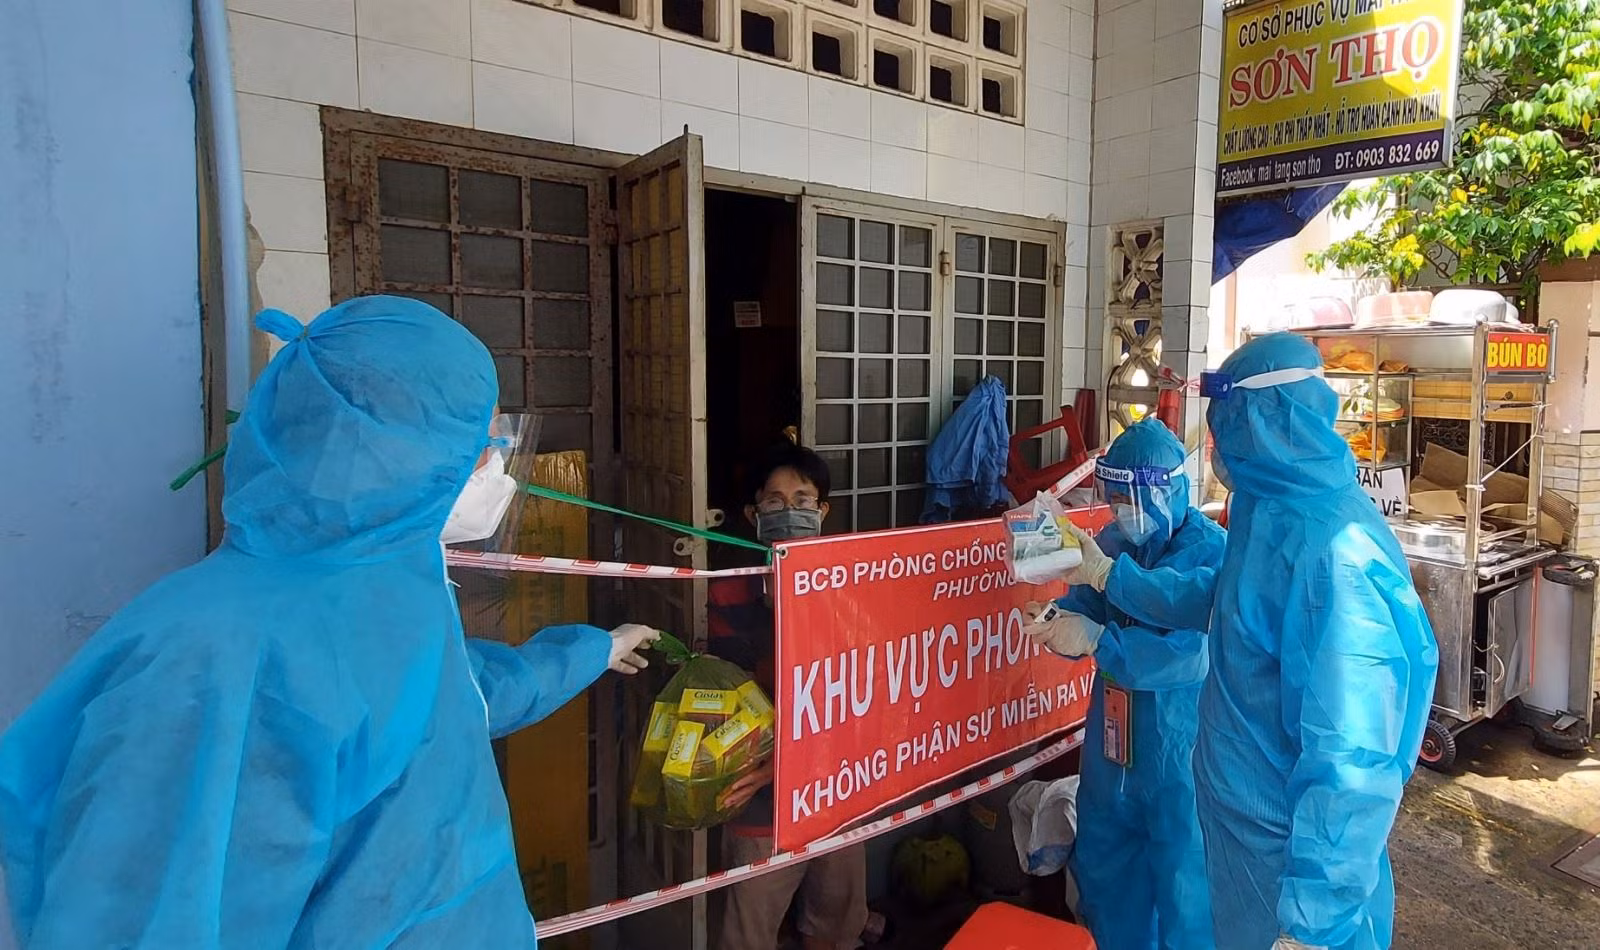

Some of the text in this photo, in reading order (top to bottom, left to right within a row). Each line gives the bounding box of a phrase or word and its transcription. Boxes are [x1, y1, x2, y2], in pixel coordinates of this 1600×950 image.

[1239, 18, 1258, 48] CƠ
[1261, 5, 1282, 41] SỞ
[1284, 2, 1325, 34] PHỤC
[1330, 0, 1350, 24] VỤ
[1229, 20, 1439, 108] SƠN THỌ
[1224, 122, 1238, 155] CHẤT
[1239, 124, 1257, 157] LƯỢNG
[1257, 124, 1269, 149] CAO
[1273, 121, 1283, 147] CHI
[1284, 113, 1297, 145] PHÍ
[1297, 107, 1313, 142] THẤP
[1313, 102, 1331, 139] NHẤT
[1347, 104, 1361, 136] TRỢ
[1361, 97, 1380, 131] HOÀN
[1381, 91, 1401, 129] CẢNH
[1221, 139, 1440, 187] Facebook: mai tang son tho ĐT: 0903 832 669
[1488, 338, 1547, 367] BÚN BÒ
[1102, 467, 1130, 481] Shield
[794, 537, 1007, 596] BCĐ PHÒNG CHỐNG
[694, 690, 725, 700] Custas
[793, 645, 875, 740] KHU
[886, 624, 959, 714] VỰC
[792, 749, 887, 822] KHÔNG
[896, 720, 961, 764] PHẬN
[966, 705, 996, 743] SỰ
[1001, 680, 1053, 729] MIỄN
[1057, 679, 1078, 710] RA
